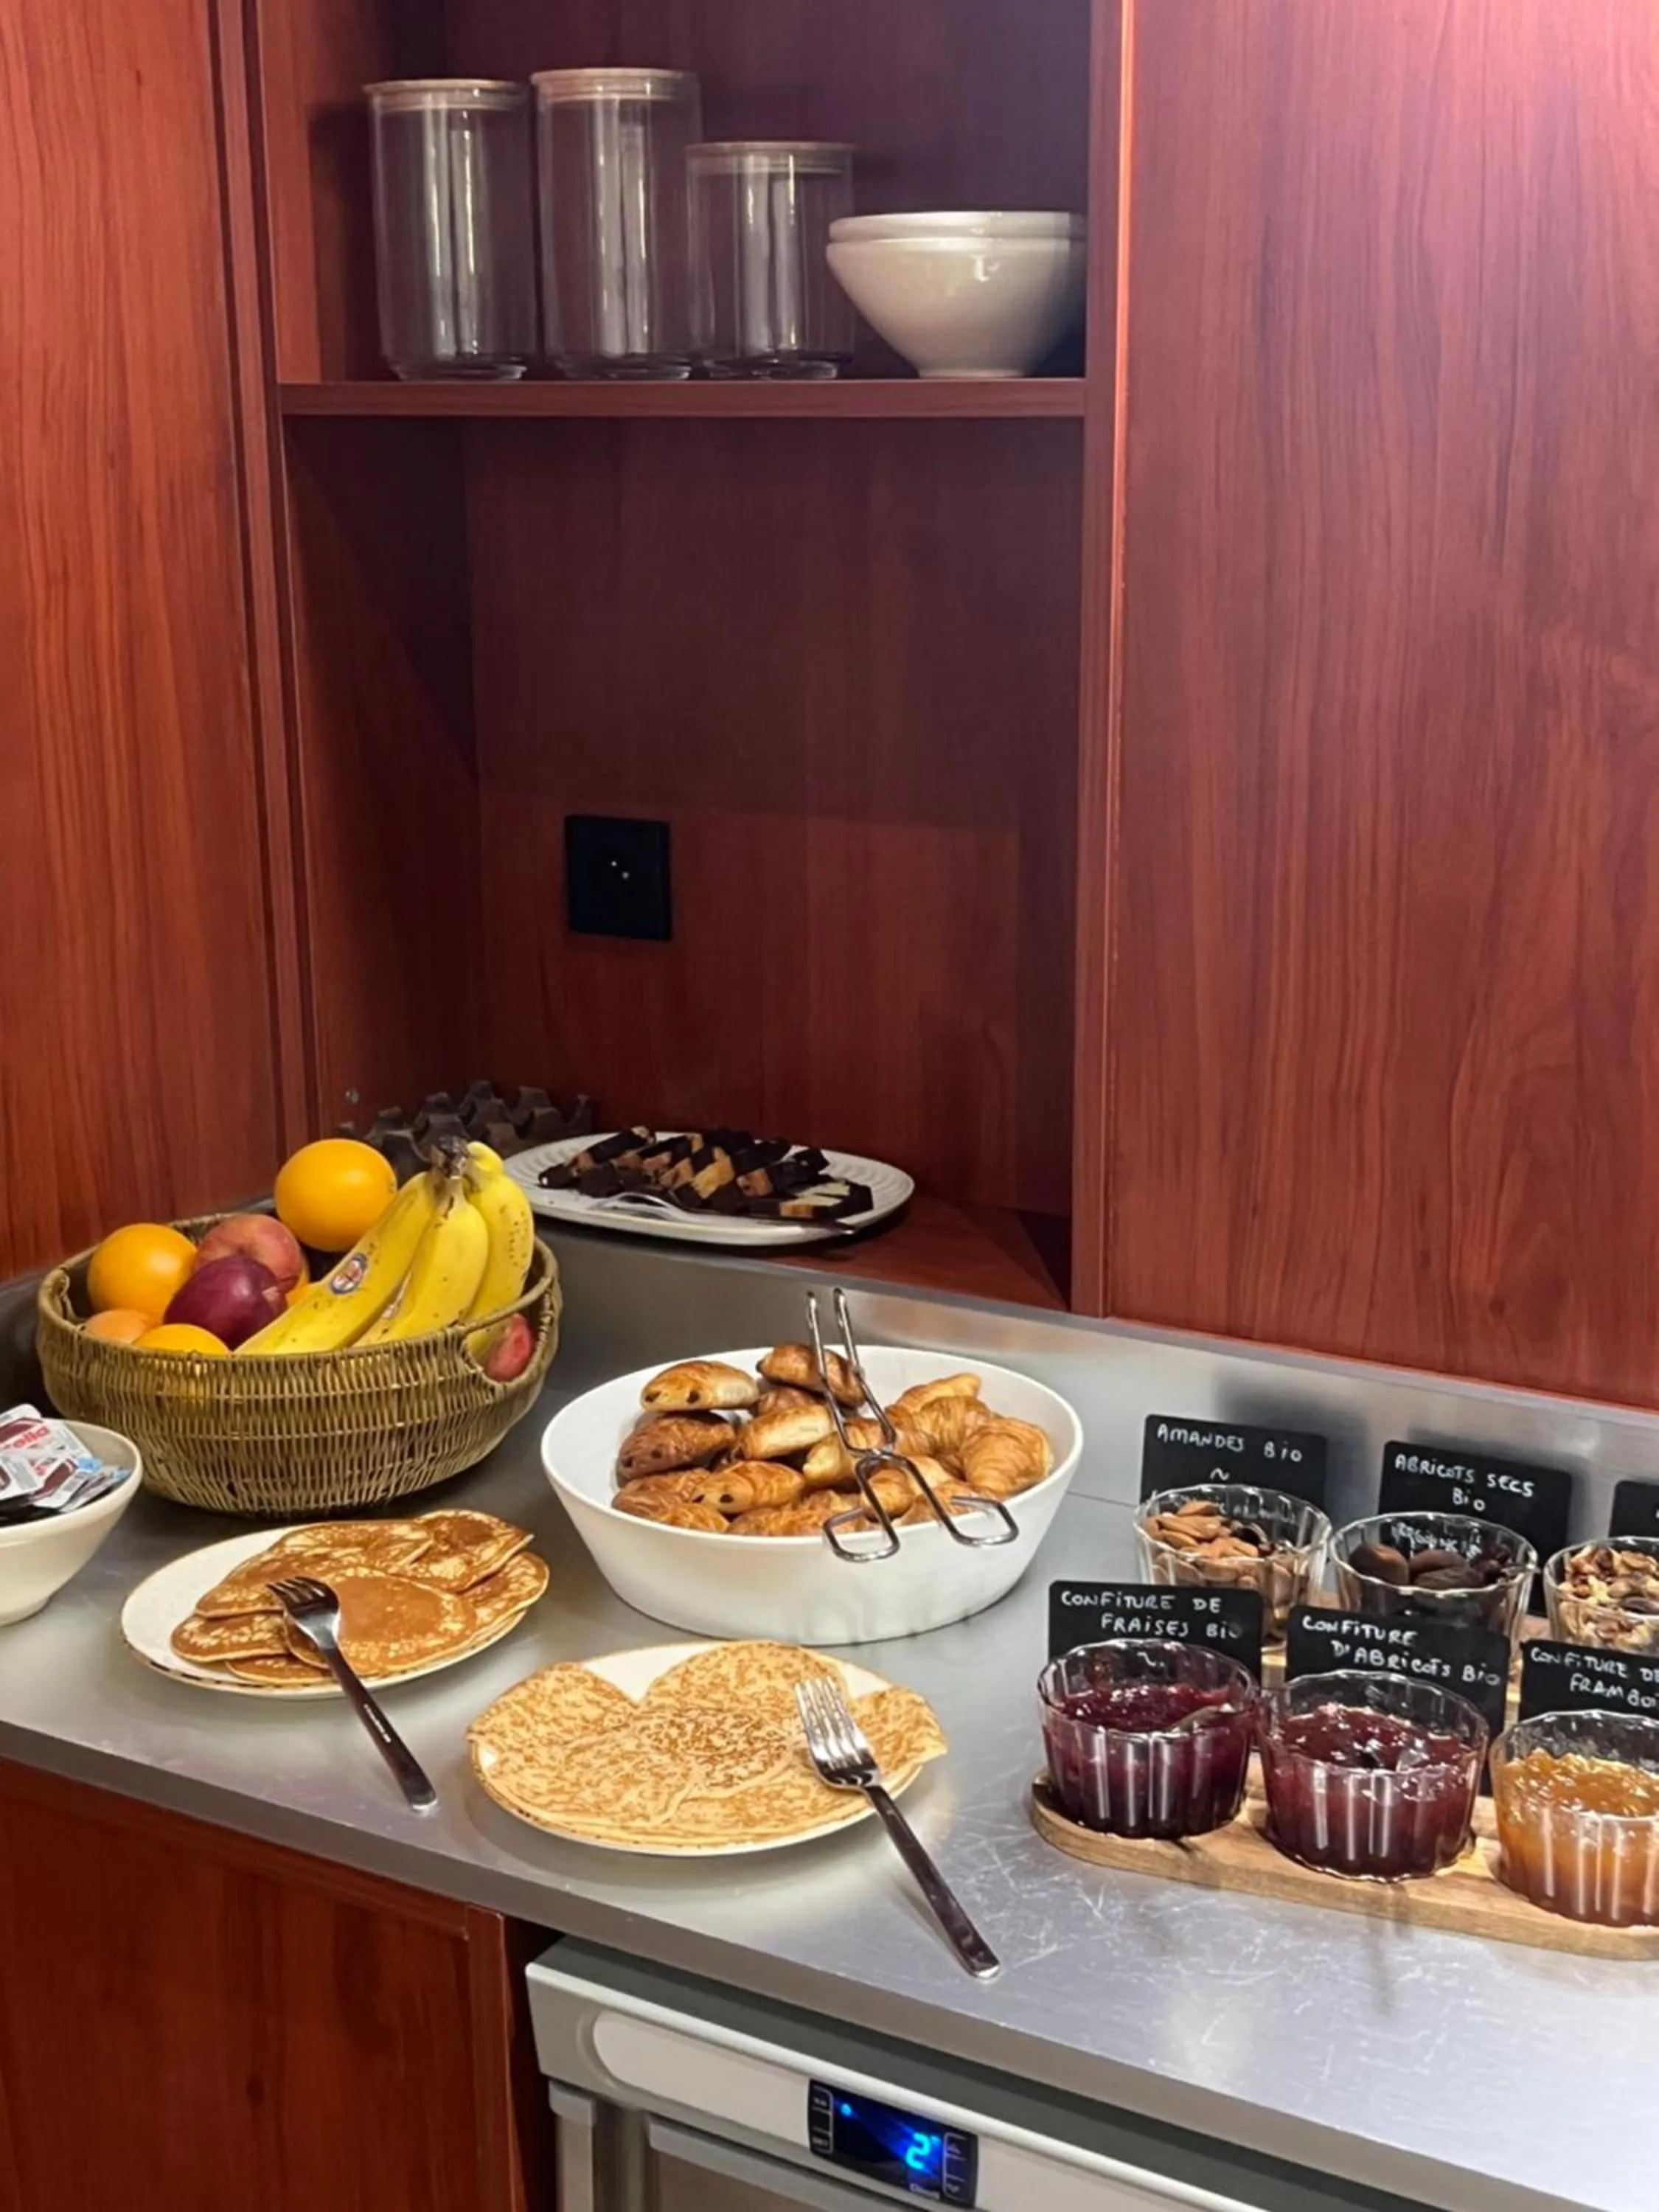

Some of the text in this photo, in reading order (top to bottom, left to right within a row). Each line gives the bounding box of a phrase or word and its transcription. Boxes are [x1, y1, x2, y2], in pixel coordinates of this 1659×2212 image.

[1157, 1423, 1245, 1453] AMANDES
[1486, 1473, 1534, 1498] SECS
[1192, 1597, 1222, 1613] DE
